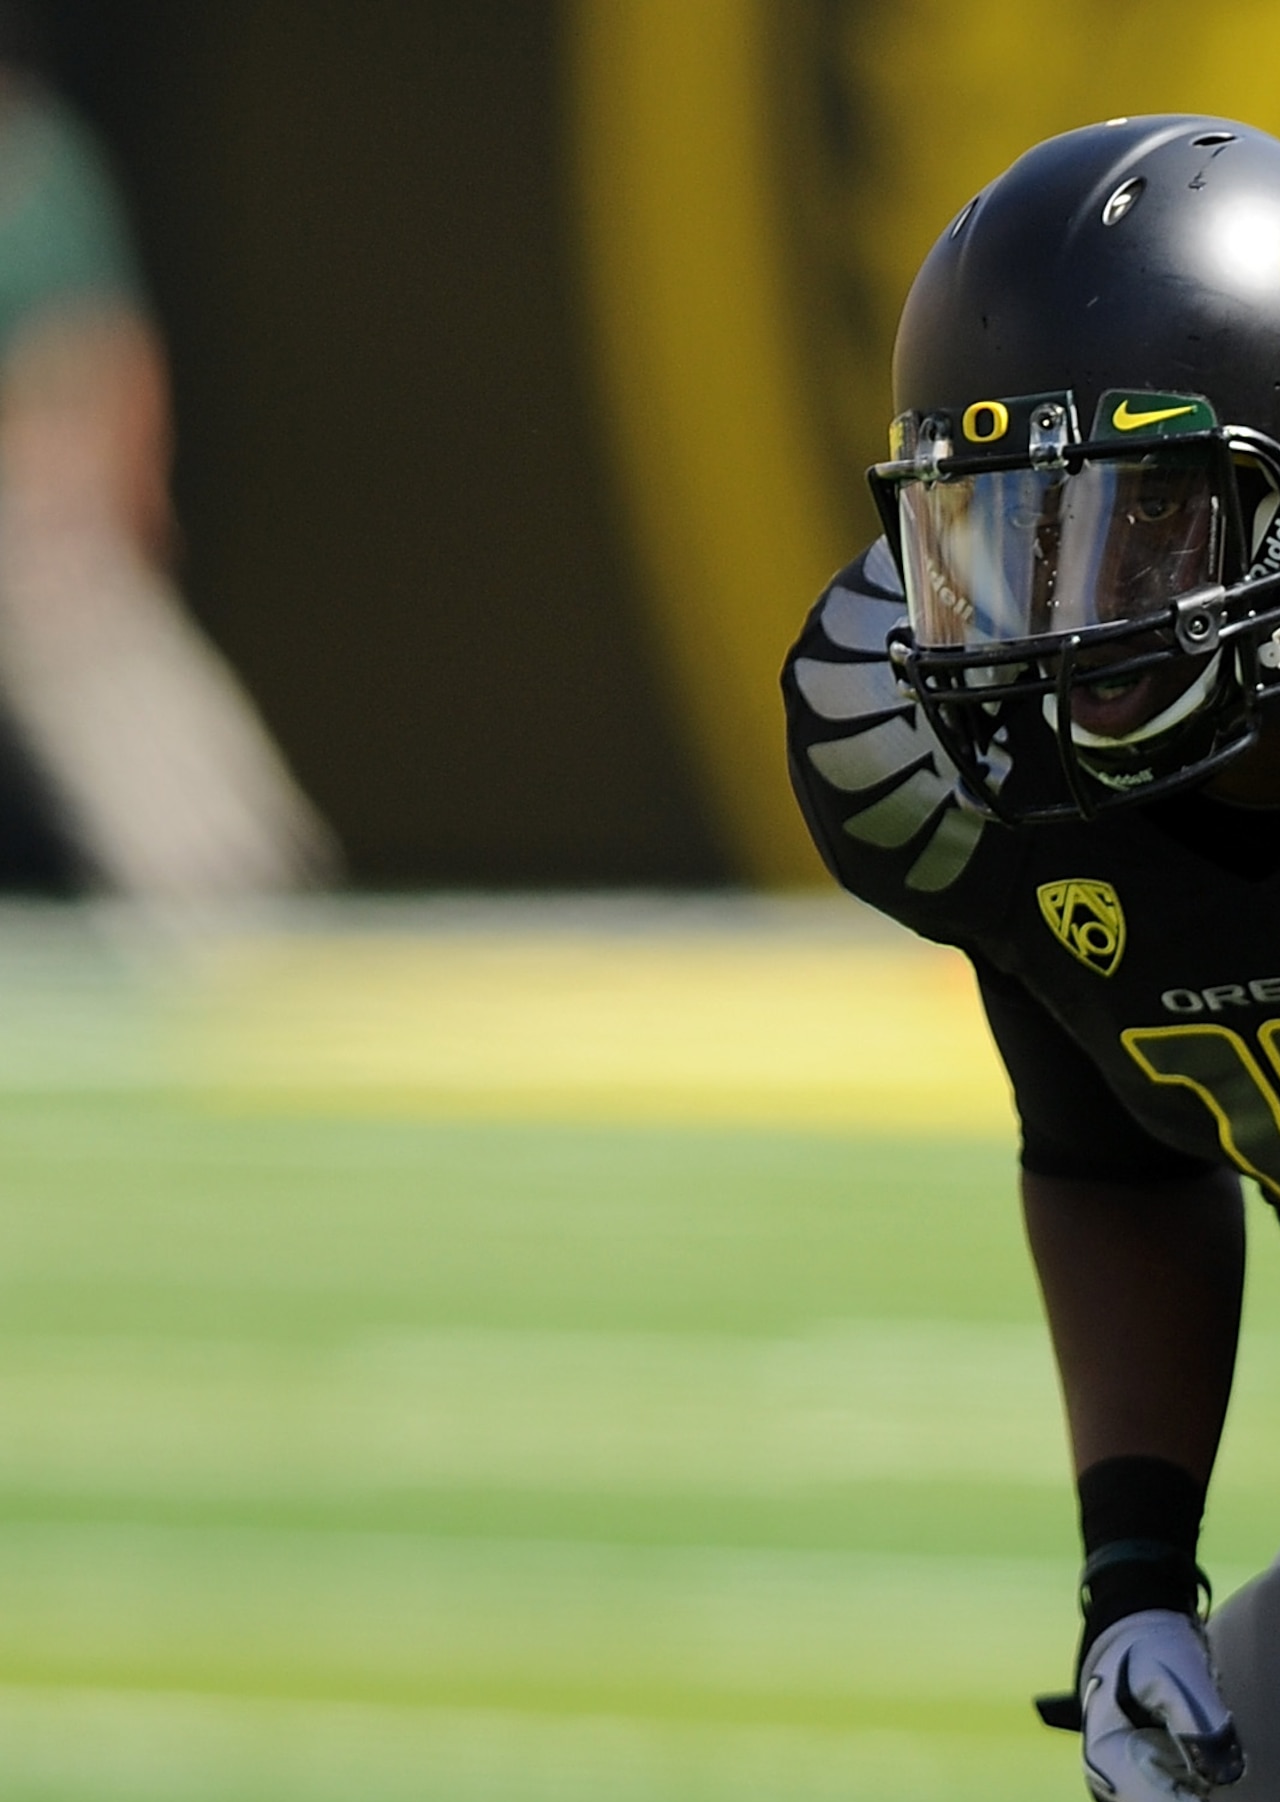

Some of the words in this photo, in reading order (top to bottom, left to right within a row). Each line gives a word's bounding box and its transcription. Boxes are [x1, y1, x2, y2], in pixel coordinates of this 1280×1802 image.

[962, 400, 1009, 442] O
[1040, 883, 1118, 939] PAC
[1071, 921, 1116, 956] 10
